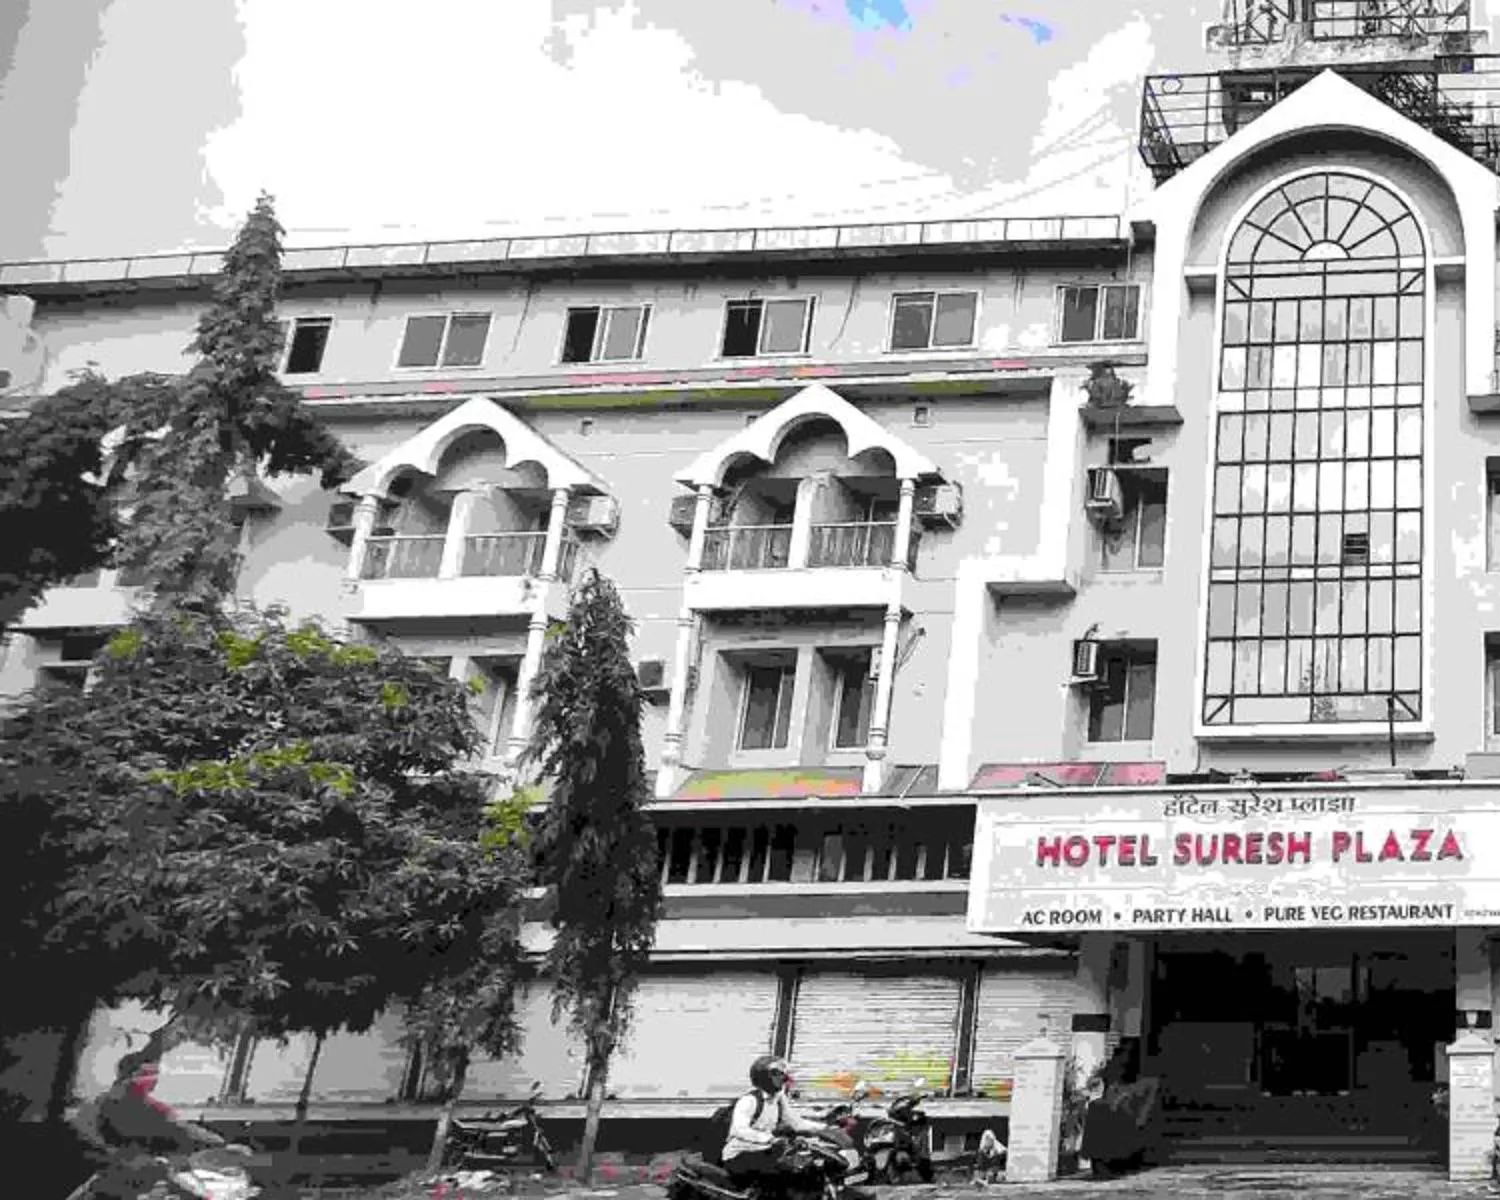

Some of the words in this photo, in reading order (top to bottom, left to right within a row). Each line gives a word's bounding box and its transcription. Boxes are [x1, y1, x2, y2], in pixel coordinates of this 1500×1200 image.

[1227, 791, 1283, 819] सुरेश
[1290, 796, 1357, 814] प्लाझा
[1035, 834, 1159, 868] HOTEL
[1172, 831, 1312, 867] SURESH
[1331, 828, 1464, 864] PLAZA
[1022, 909, 1046, 925] AC
[1049, 908, 1102, 925] ROOM
[1132, 907, 1187, 924] PARTY
[1191, 907, 1233, 923] HALL
[1263, 905, 1306, 922] PURE
[1310, 904, 1344, 921] VEG
[1348, 903, 1455, 921] RESTAURANT
